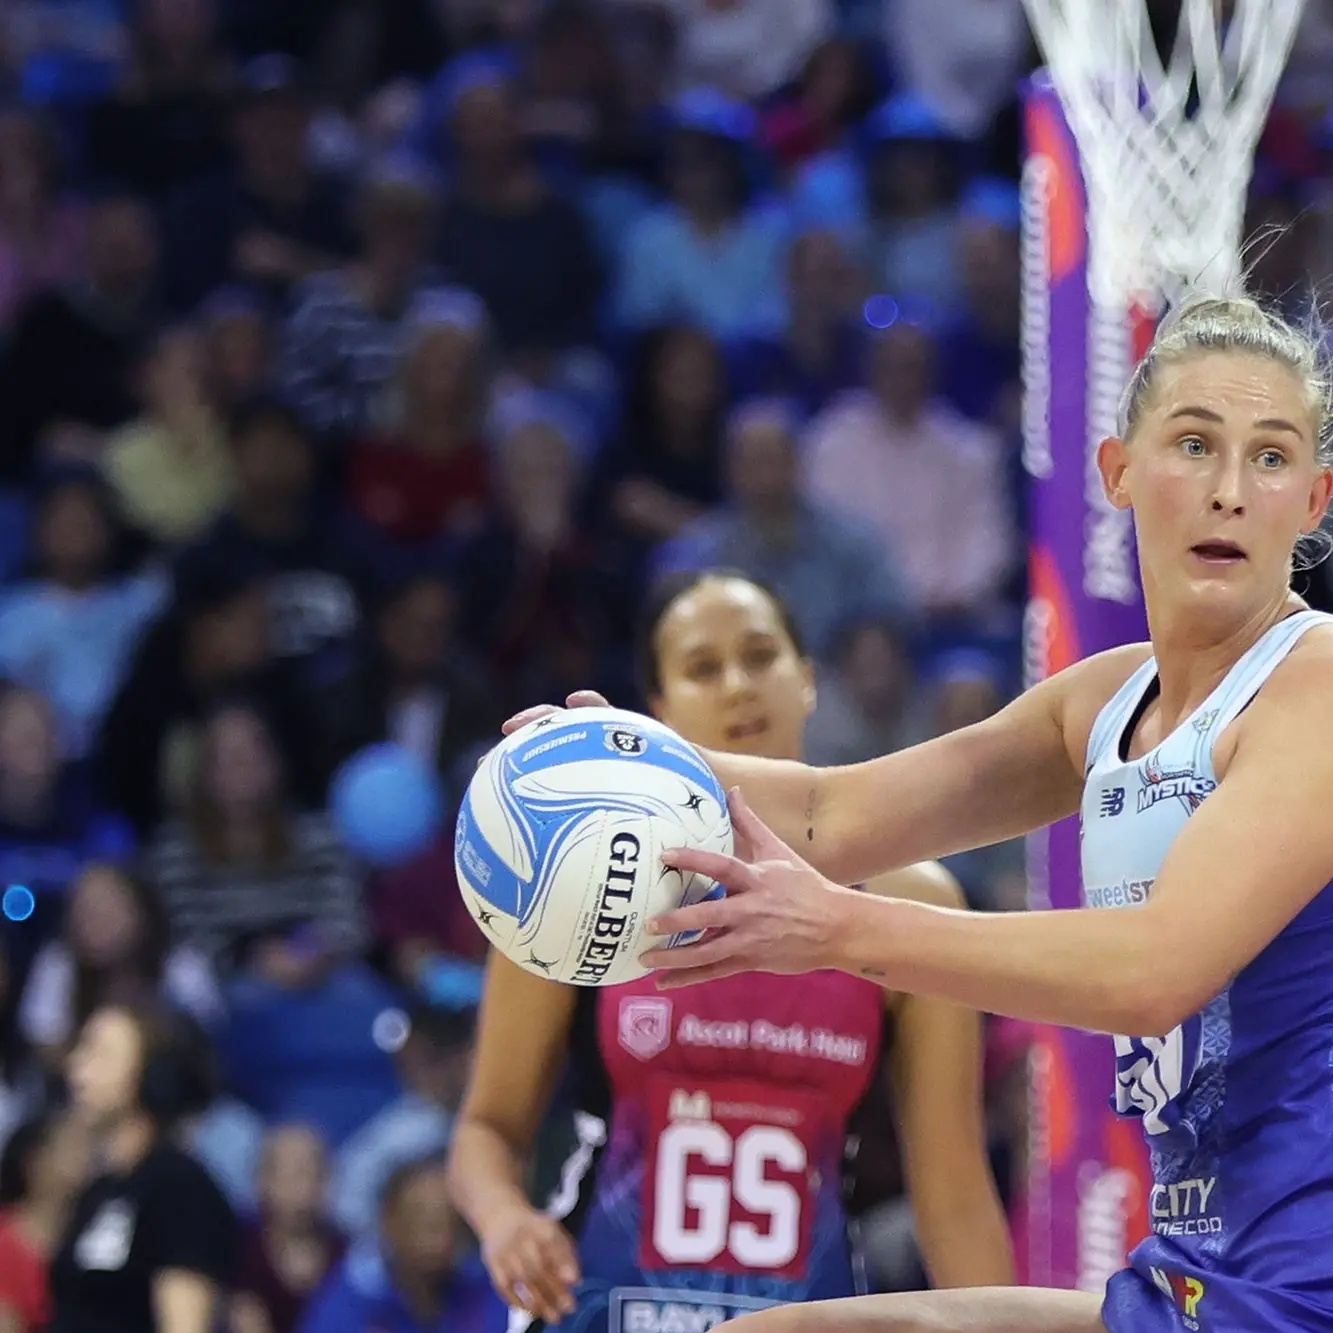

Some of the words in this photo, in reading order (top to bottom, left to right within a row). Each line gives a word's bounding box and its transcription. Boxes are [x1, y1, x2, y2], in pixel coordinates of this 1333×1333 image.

[570, 832, 640, 985] GILBERT
[652, 1119, 807, 1268] GS
[1151, 1176, 1216, 1218] CITY
